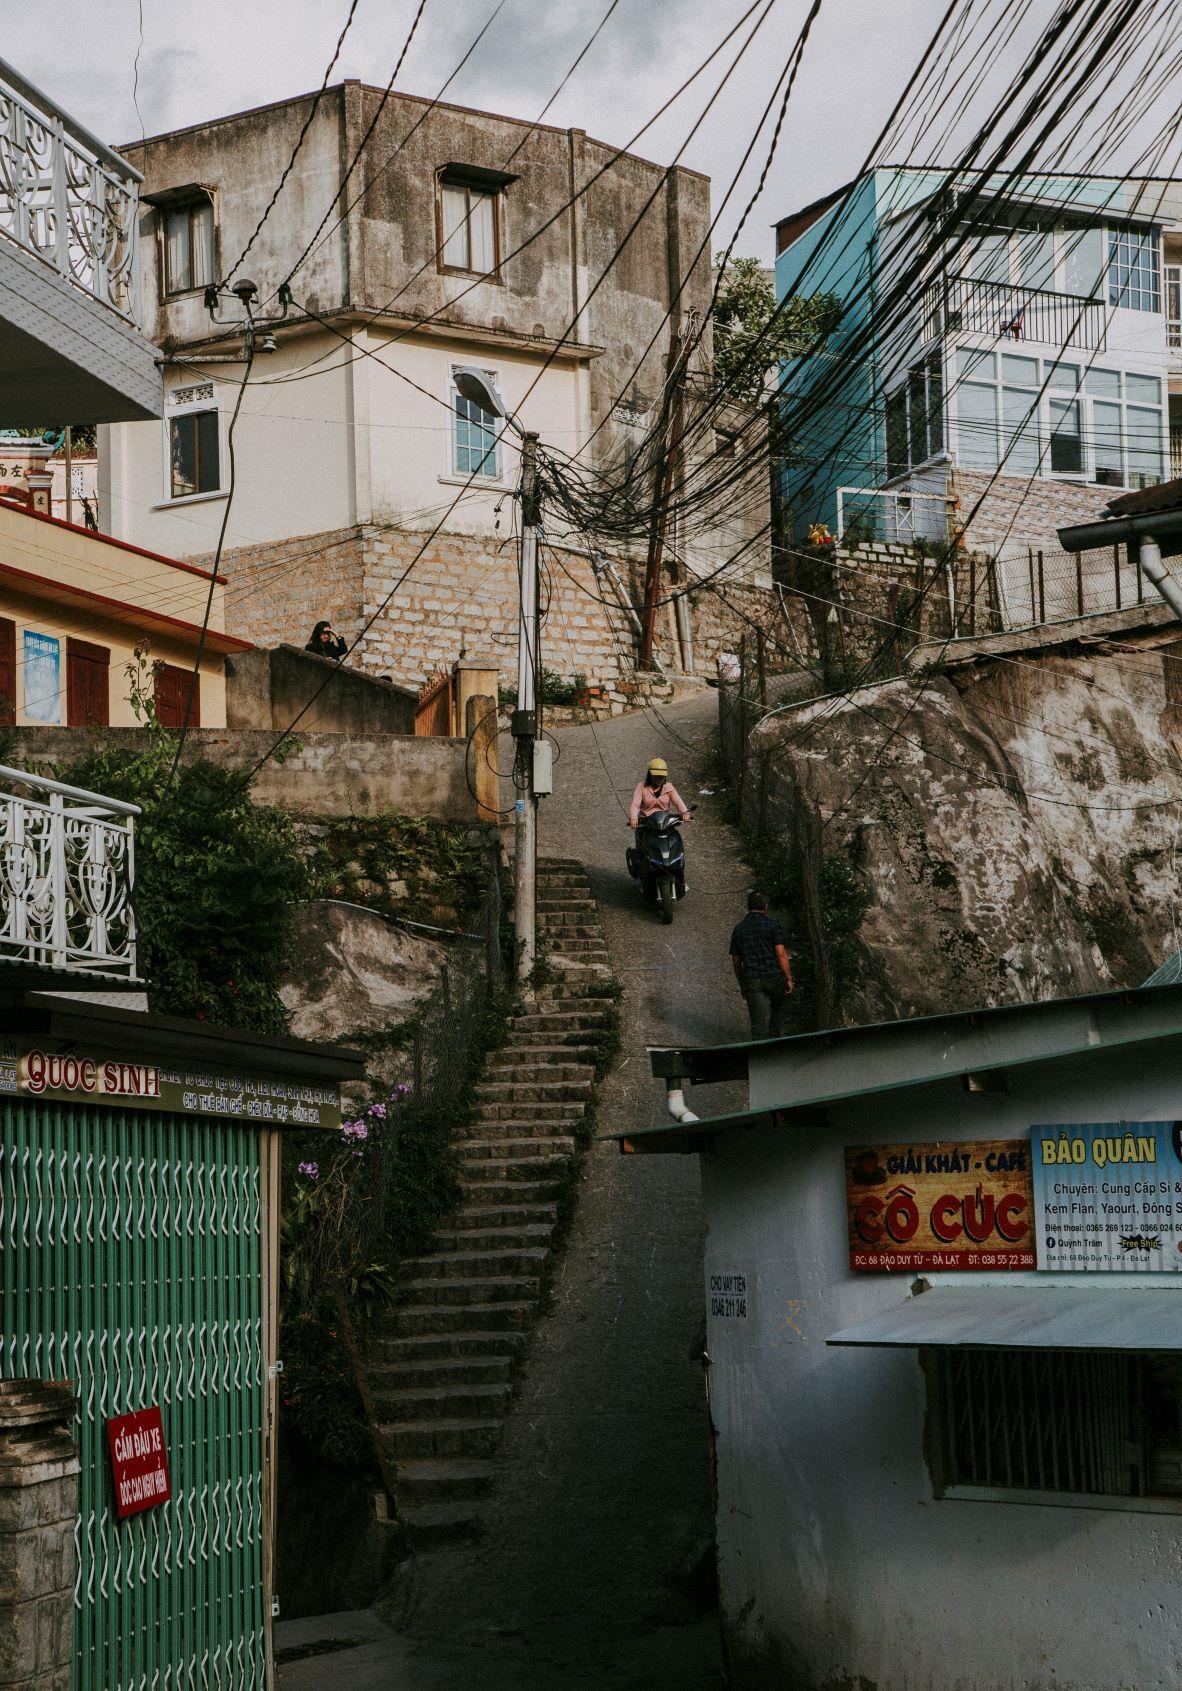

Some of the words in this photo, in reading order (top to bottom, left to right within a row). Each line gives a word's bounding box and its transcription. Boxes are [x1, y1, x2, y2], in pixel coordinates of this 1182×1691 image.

[104, 1060, 161, 1097] SINH
[1041, 1131, 1086, 1165] BẢO
[1092, 1131, 1156, 1168] QUÂN
[887, 1148, 923, 1175] GIẢI
[925, 1148, 972, 1174] KHÁT
[1053, 1183, 1098, 1196] Chuyên:
[1101, 1184, 1131, 1196] Cung
[1134, 1178, 1156, 1196] Cấp
[855, 1183, 920, 1243] CÔ
[930, 1182, 1029, 1243] CÚC
[1044, 1203, 1068, 1214] Kem
[1071, 1203, 1098, 1215] Flan,
[1101, 1203, 1139, 1215] Yaourt,
[1143, 1202, 1172, 1216] Đông
[1120, 1224, 1133, 1232] 123
[1121, 1240, 1138, 1248] Free
[1140, 1239, 1158, 1249] Ship
[897, 1255, 911, 1265] DUY
[997, 1254, 1007, 1265] 55
[1009, 1254, 1019, 1265] 22
[711, 1275, 721, 1291] CHO
[723, 1276, 733, 1291] VAY
[115, 1426, 134, 1462] CẤM
[150, 1427, 161, 1452] XE
